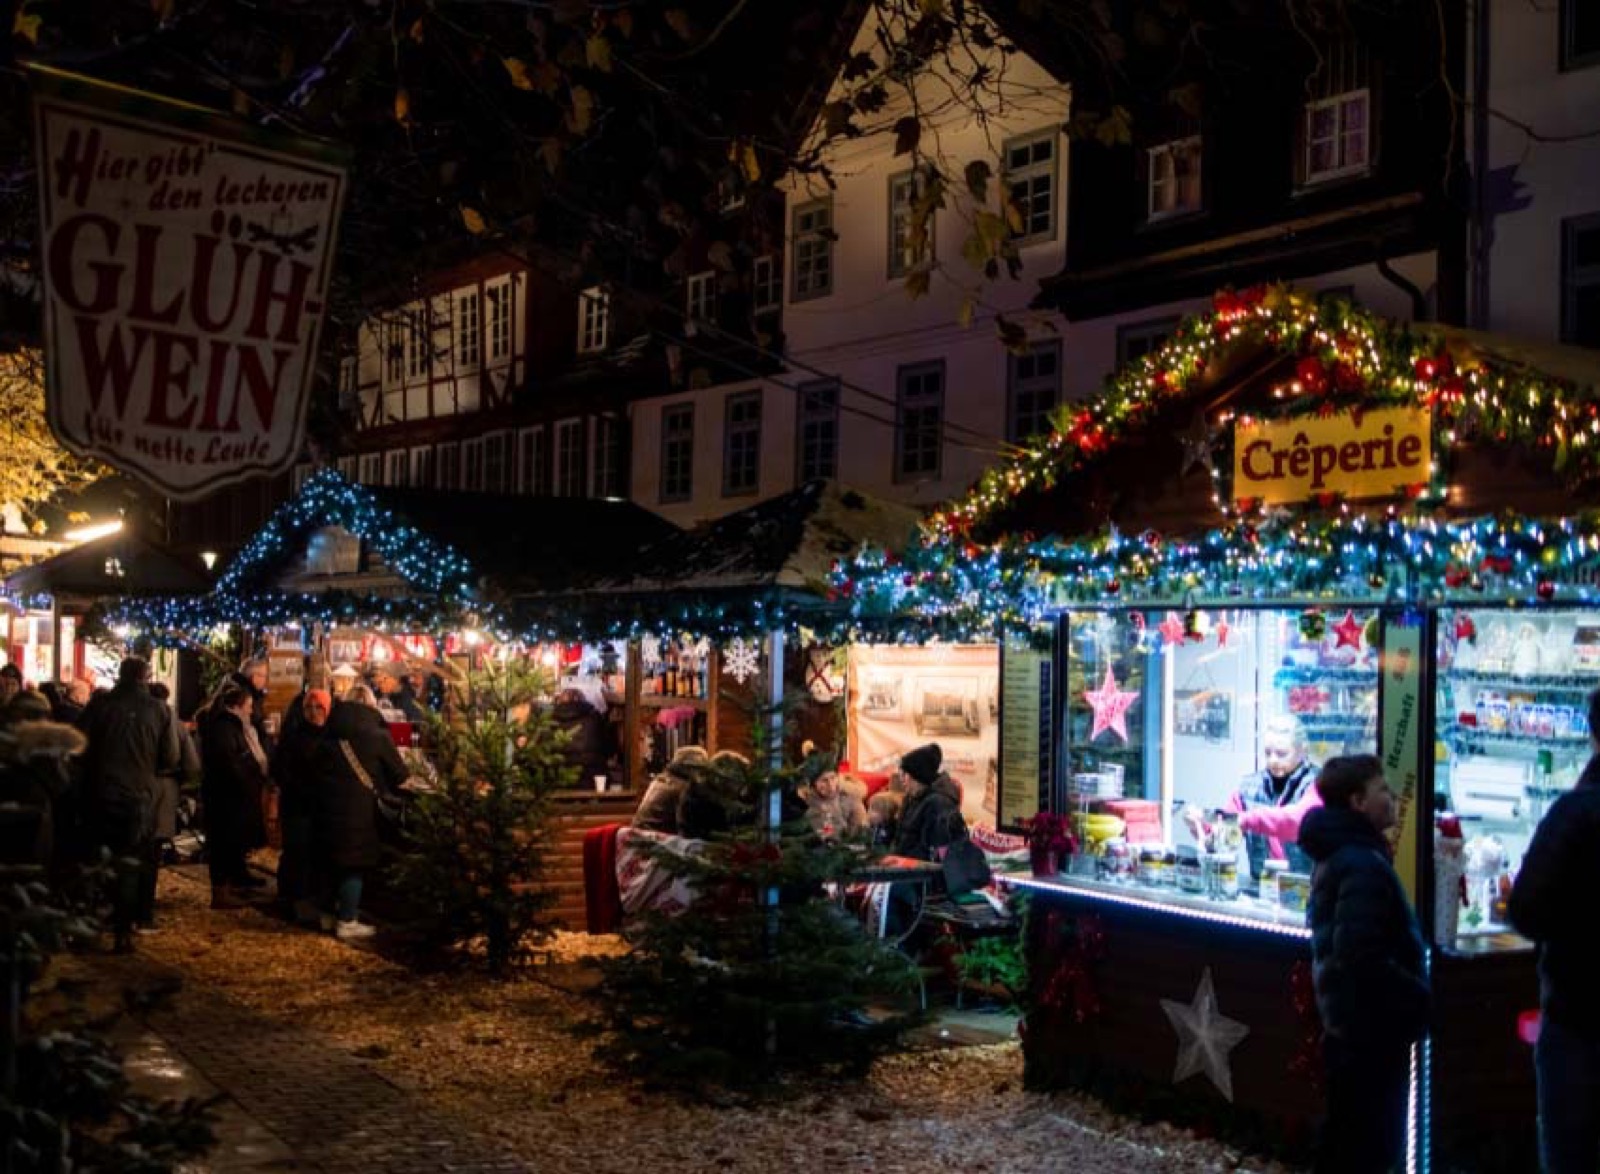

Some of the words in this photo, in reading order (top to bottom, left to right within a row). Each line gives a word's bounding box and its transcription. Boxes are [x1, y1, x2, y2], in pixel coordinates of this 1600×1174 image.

[54, 127, 138, 207] Hier
[150, 180, 203, 211] den
[215, 174, 329, 205] leckeren
[50, 209, 325, 346] GLÜH-
[74, 315, 291, 433] WEIN
[134, 433, 195, 465] nette
[202, 434, 271, 464] Leute
[1241, 424, 1422, 489] Crêperie
[1387, 692, 1415, 769] Herzhaft
